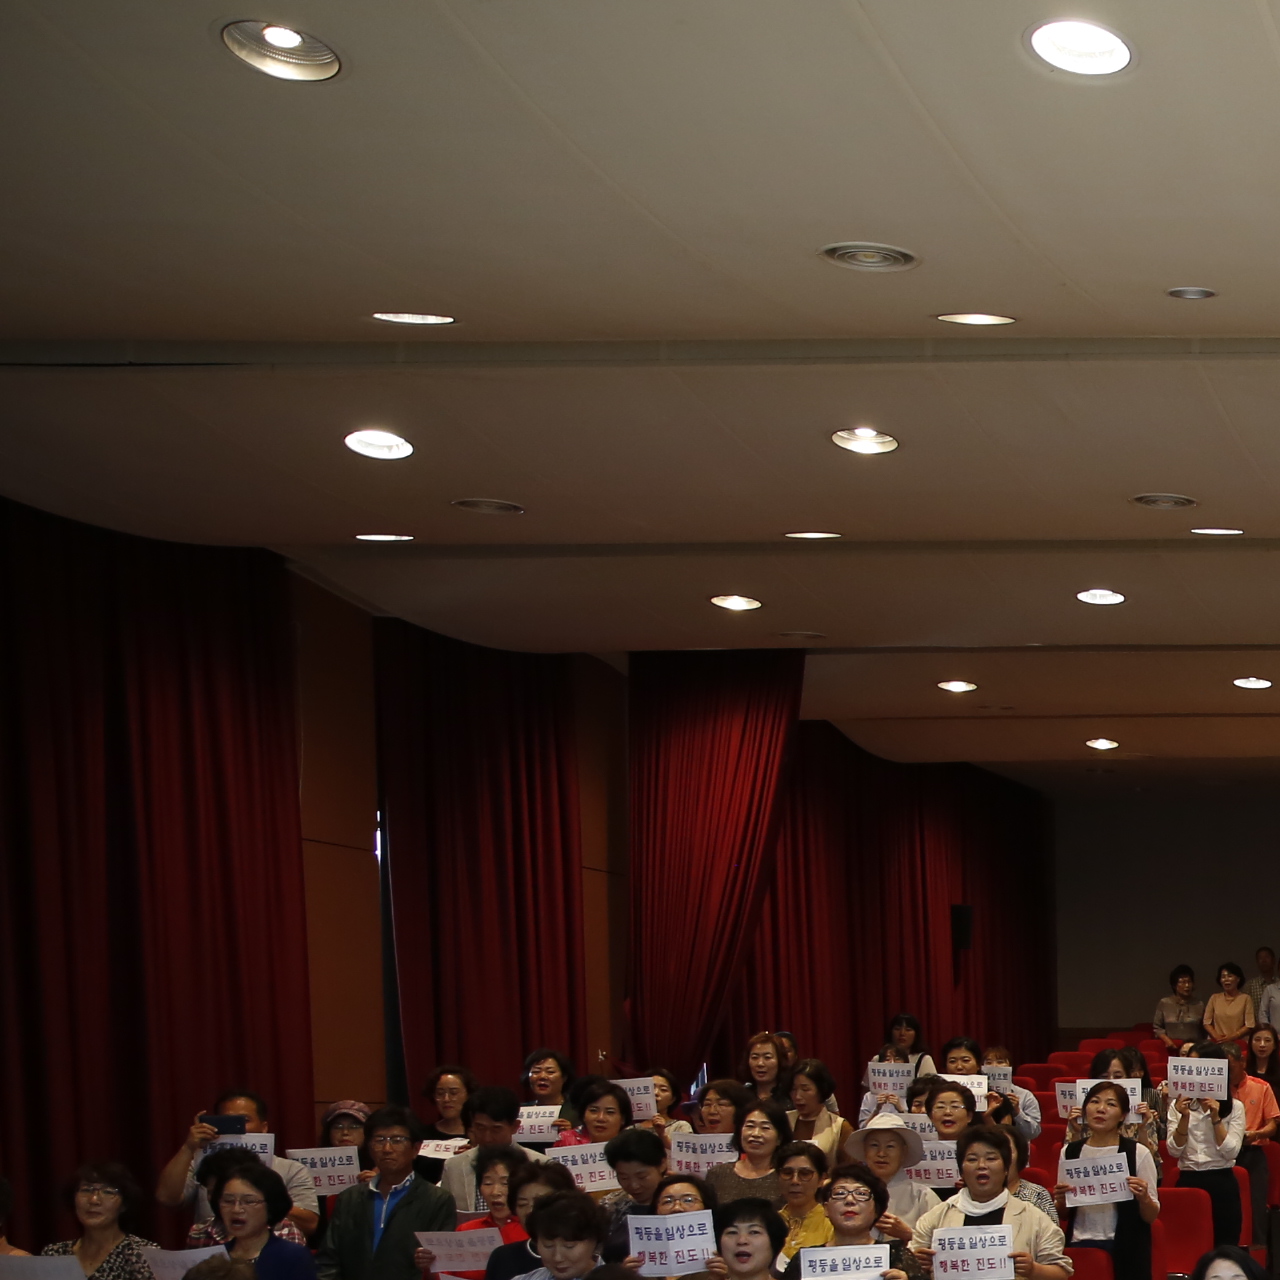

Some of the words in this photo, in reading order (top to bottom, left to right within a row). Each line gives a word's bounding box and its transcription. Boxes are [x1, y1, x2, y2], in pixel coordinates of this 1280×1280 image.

[1172, 1064, 1193, 1076] 평등을
[1195, 1065, 1223, 1077] 일상으로
[1171, 1081, 1194, 1092] 행복한
[1066, 1166, 1091, 1179] 평등을
[1092, 1163, 1124, 1177] 일상으로
[1100, 1181, 1127, 1195] 진도!!
[634, 1225, 663, 1241] 평등을
[665, 1222, 708, 1240] 일상으로
[936, 1237, 965, 1250] 평등을
[968, 1235, 1007, 1249] 일상으로
[637, 1251, 668, 1265] 행복한
[676, 1248, 710, 1263] 진도!!
[807, 1258, 840, 1273] 평등을
[841, 1256, 883, 1270] 일상으로
[939, 1259, 971, 1273] 행복한
[976, 1258, 1007, 1271] 진도!!
